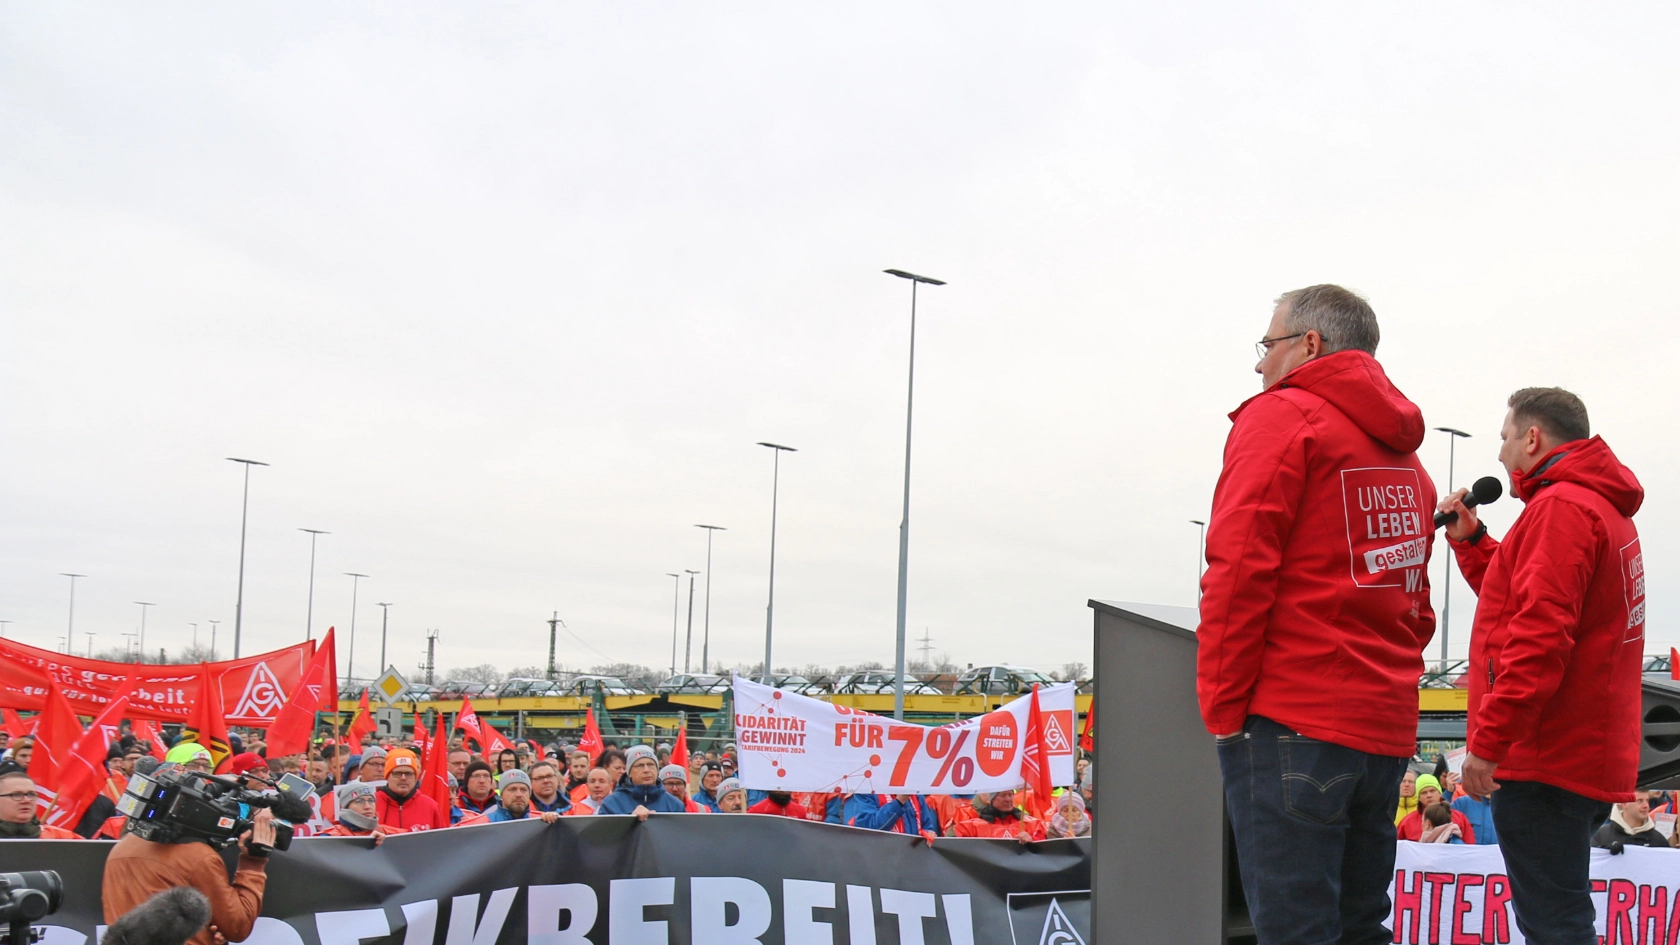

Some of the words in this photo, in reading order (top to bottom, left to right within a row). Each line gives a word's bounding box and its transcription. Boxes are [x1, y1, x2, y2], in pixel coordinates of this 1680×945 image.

[1358, 485, 1417, 511] UNSER
[1366, 511, 1421, 539] LEBEN
[1374, 539, 1426, 571] gestalt
[158, 705, 193, 715] leut
[834, 717, 884, 748] FÜR
[990, 724, 1011, 737] DAFÜR
[741, 730, 807, 746] GEWINNT
[983, 738, 1013, 749] STREITEN
[741, 744, 789, 754] TARIFBEWEGUNG
[990, 750, 1004, 760] WIR
